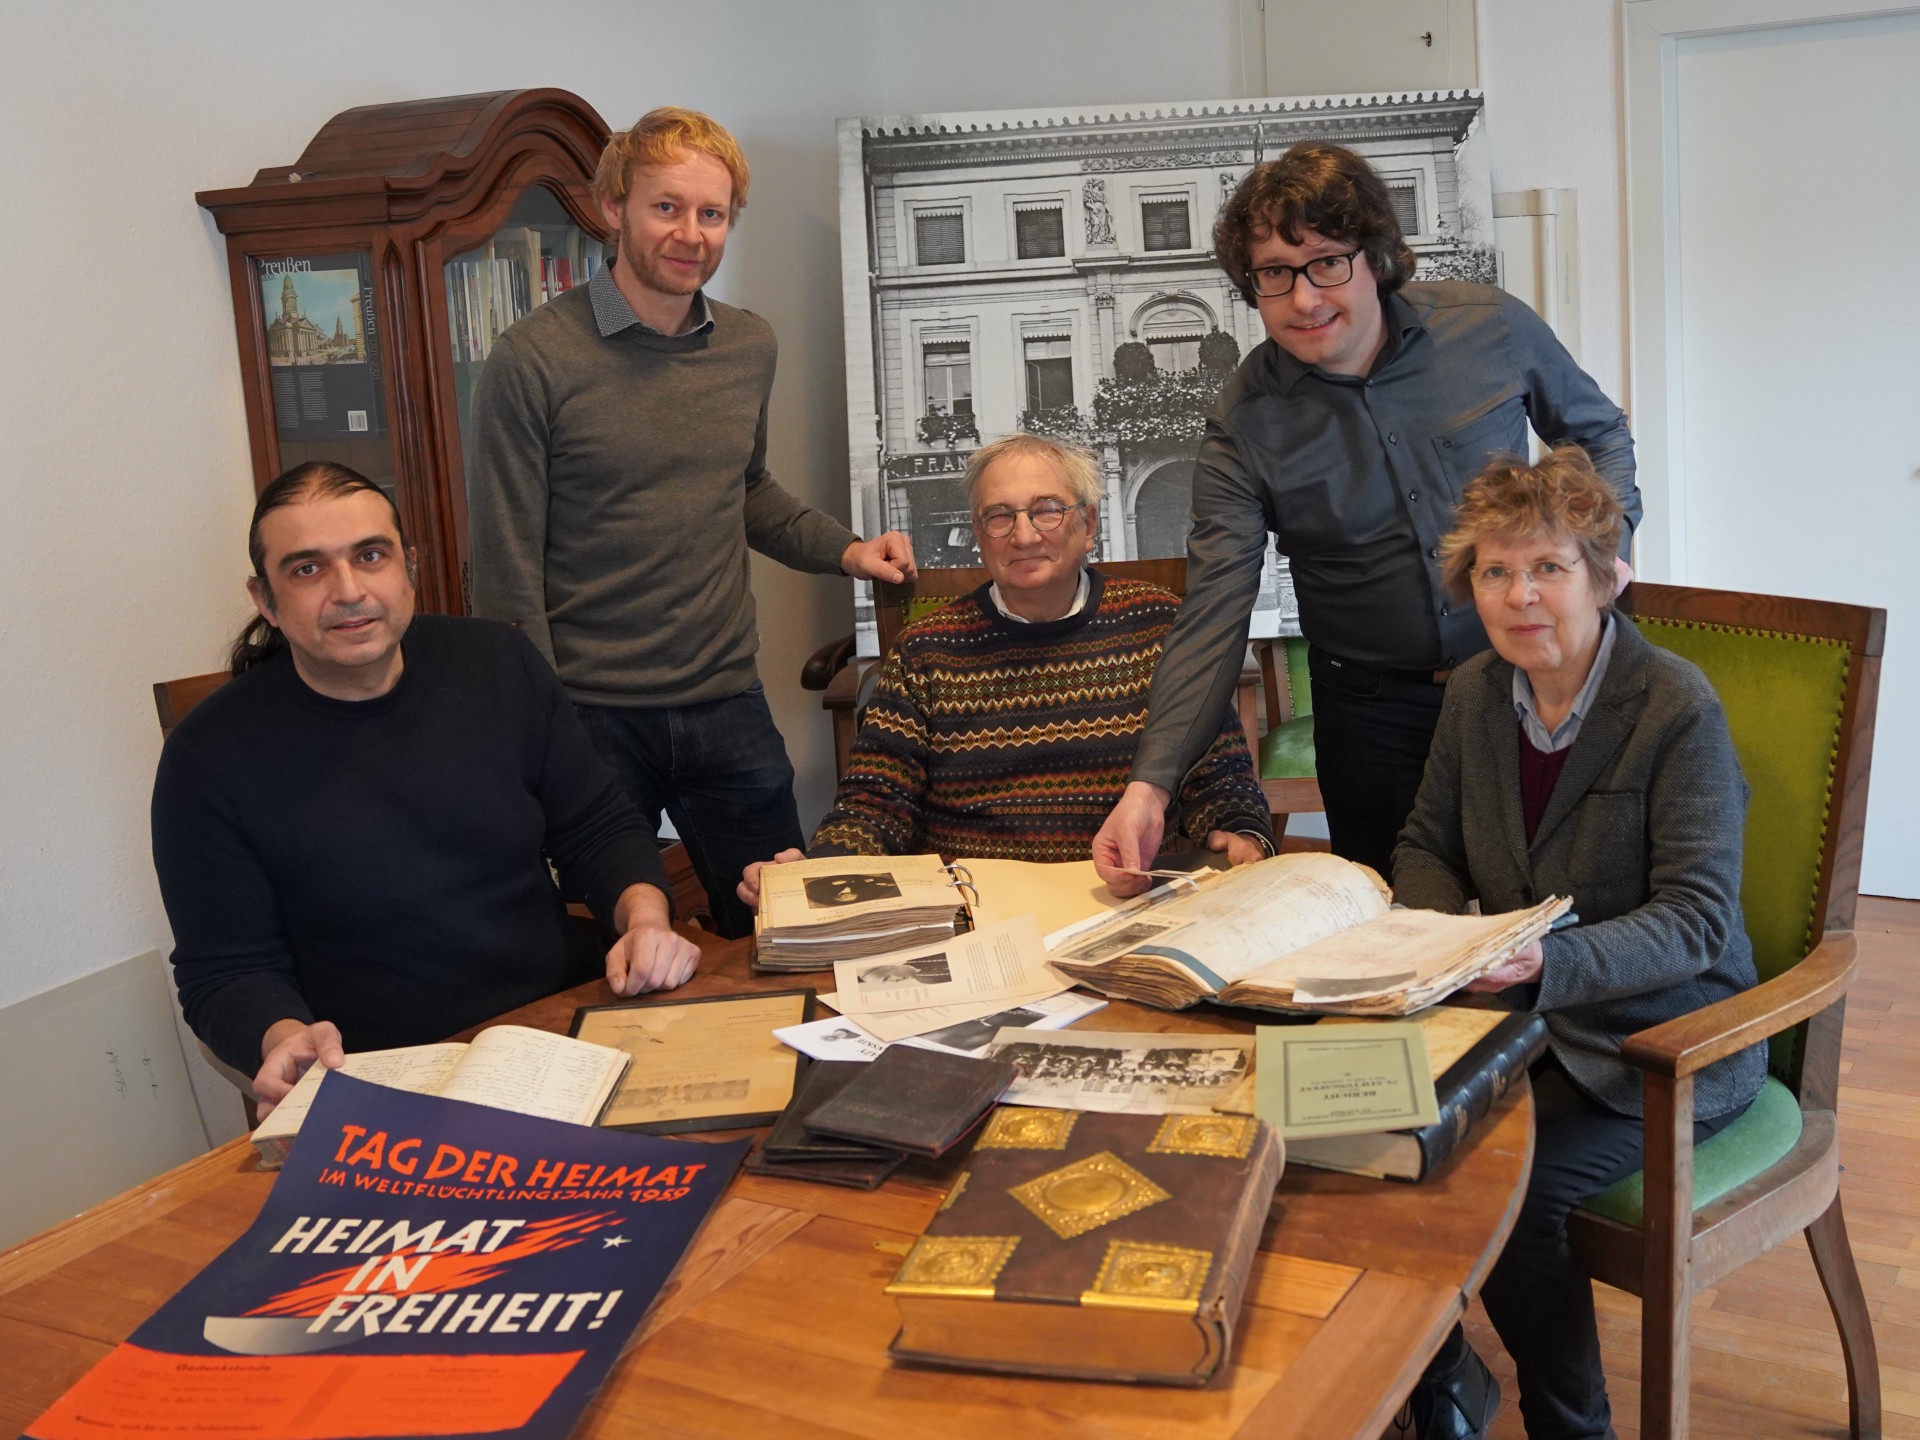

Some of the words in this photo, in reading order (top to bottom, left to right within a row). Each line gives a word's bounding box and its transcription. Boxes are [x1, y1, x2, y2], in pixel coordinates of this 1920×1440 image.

[364, 287, 376, 335] Preußen
[1323, 1090, 1377, 1100] BERICHT
[334, 1124, 423, 1176] TAG
[423, 1143, 519, 1188] DER
[525, 1159, 707, 1189] HEIMAT
[318, 1168, 347, 1187] IM
[354, 1172, 623, 1201] WELTFLÜCHTLINGSJAHR
[629, 1186, 691, 1203] 1959
[269, 1216, 526, 1253] HEIMAT
[342, 1255, 433, 1292] IN
[306, 1289, 624, 1336] FREIHEIT!
